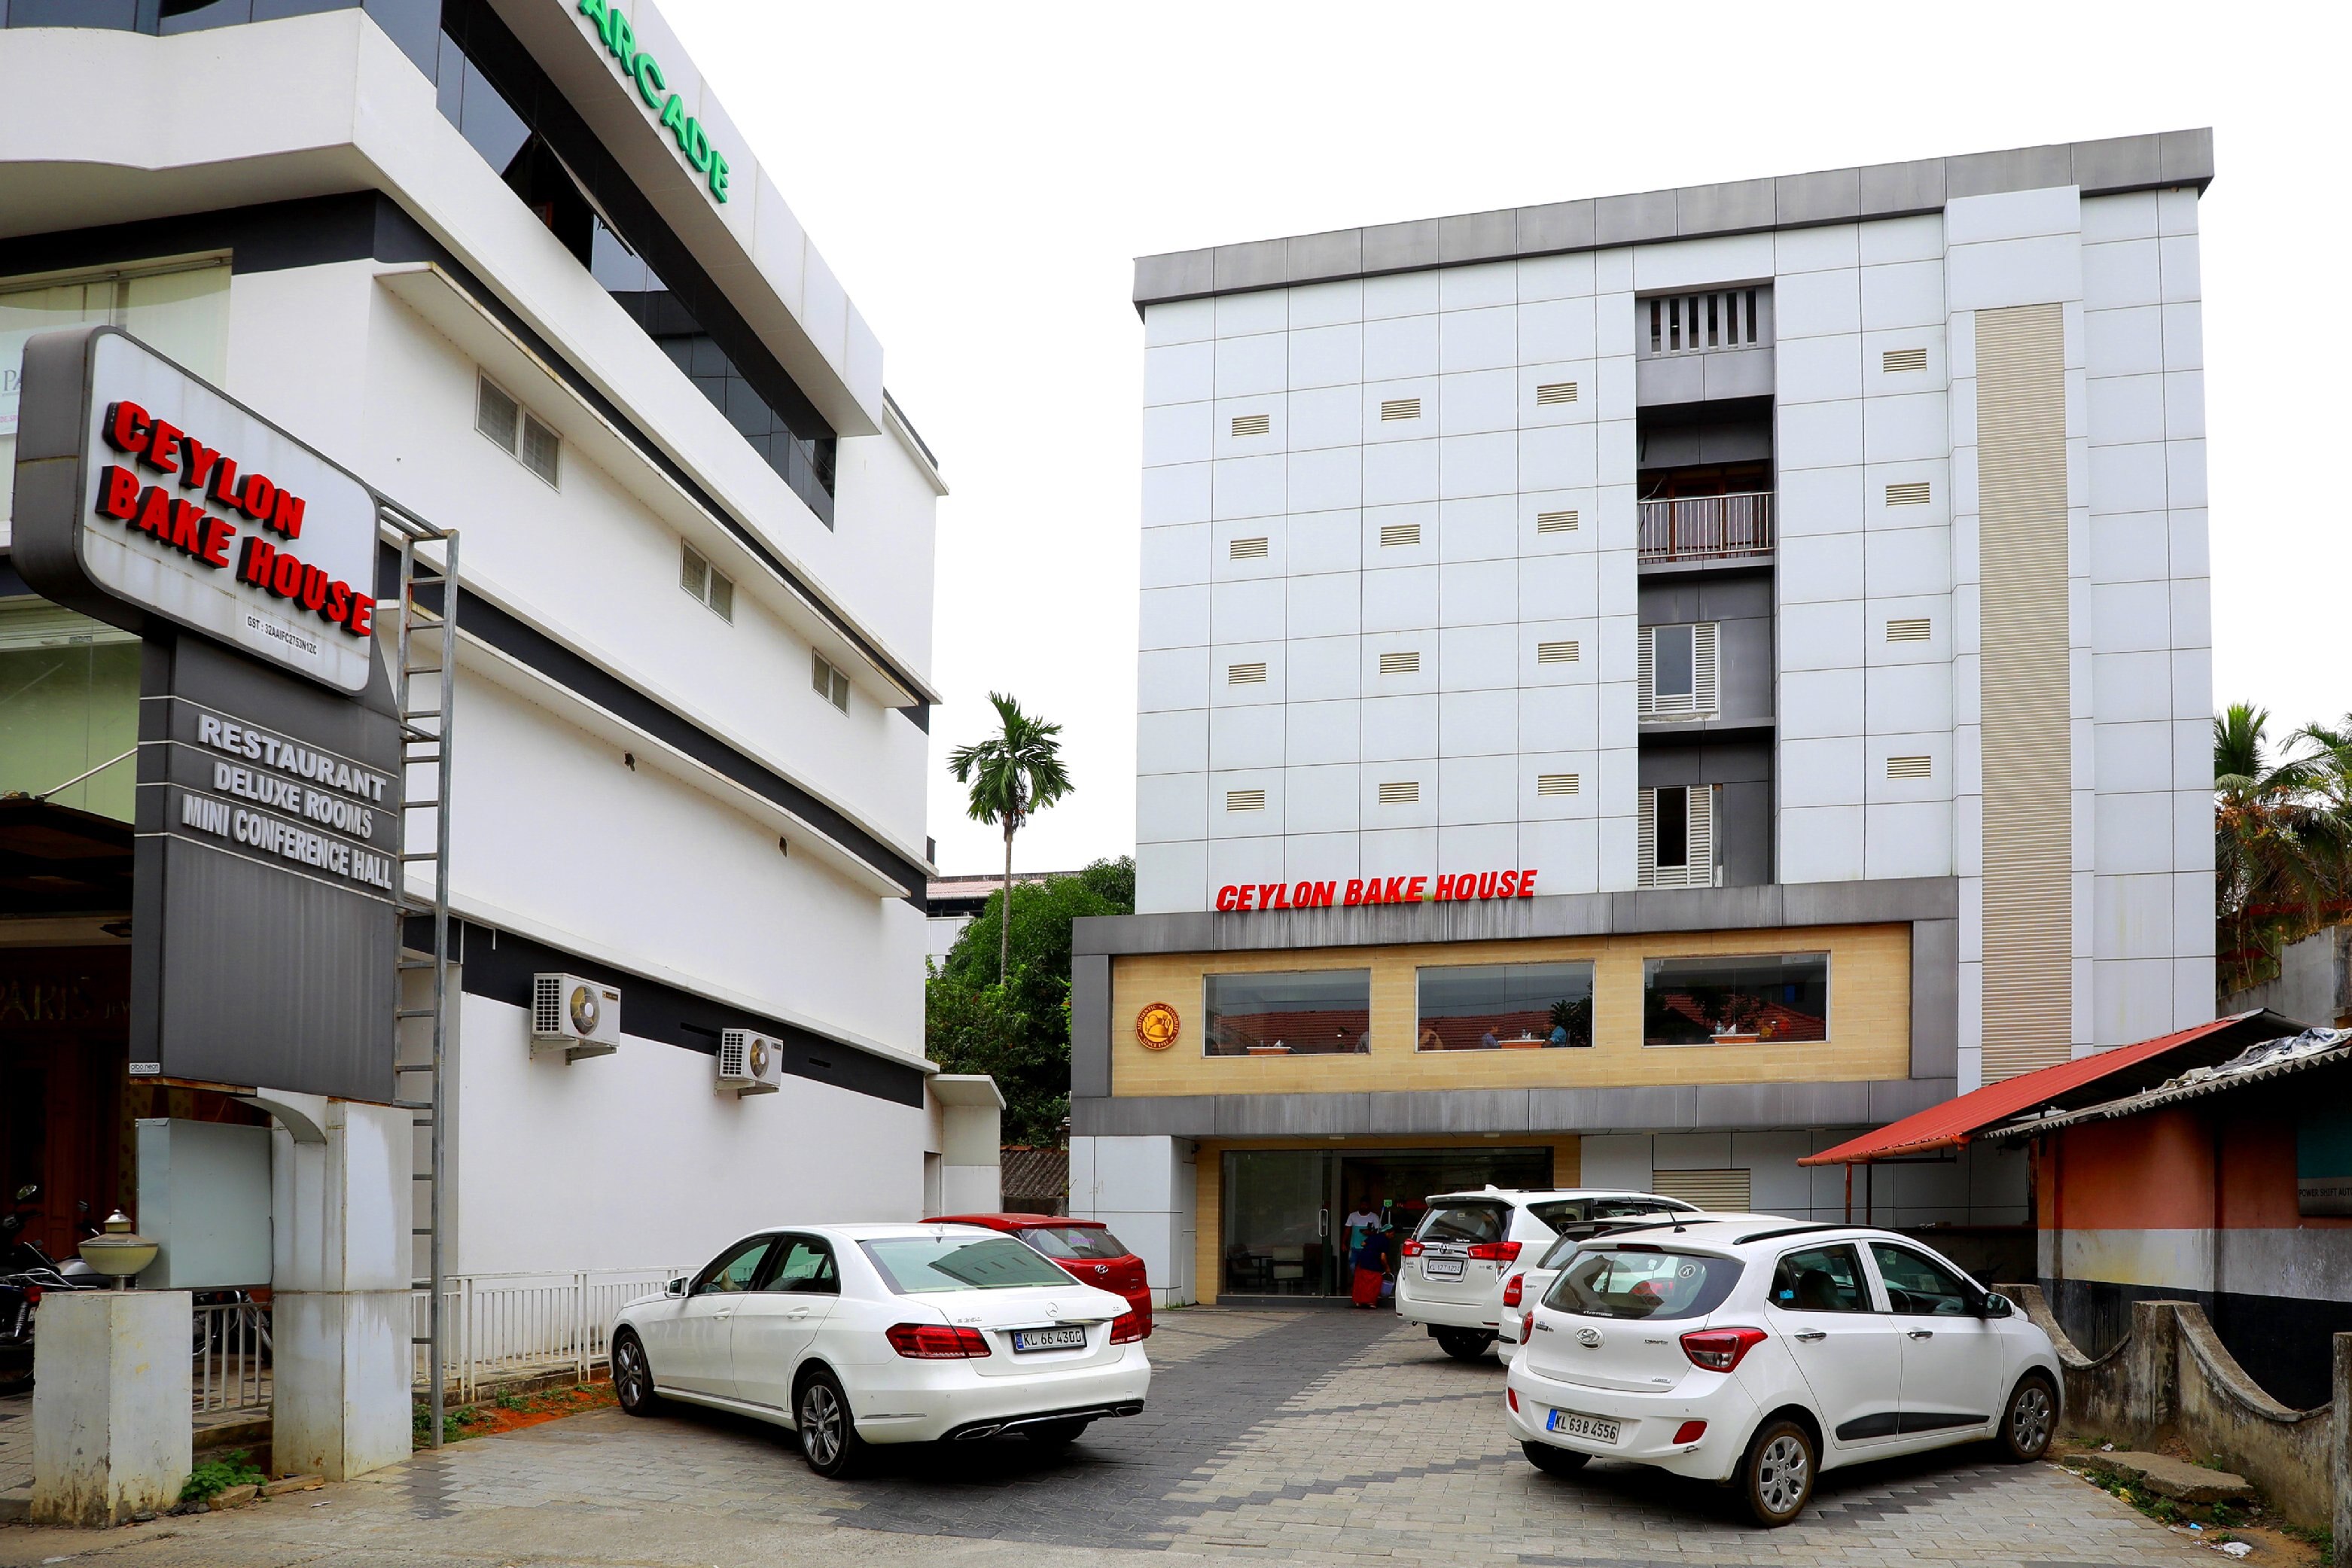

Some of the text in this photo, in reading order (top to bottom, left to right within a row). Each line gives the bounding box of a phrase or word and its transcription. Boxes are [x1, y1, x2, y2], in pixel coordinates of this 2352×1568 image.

[578, 0, 730, 203] ARCADE
[105, 400, 306, 540] CEYLON
[98, 464, 376, 638] BAKE HOUSE
[247, 616, 260, 630] GST
[198, 714, 386, 802] RESTAURANT
[213, 762, 373, 839] DELUXE ROOMS
[181, 793, 392, 891] MINI CONFERENCE HALL
[1215, 869, 1538, 912] CEYLON BAKE HOUSE
[2299, 1189, 2319, 1197] POWER
[2320, 1188, 2337, 1197] SHIFT
[1023, 1333, 1037, 1347] KL
[1040, 1332, 1053, 1345] 66
[1555, 1414, 1616, 1440] KL 63 B 4556
